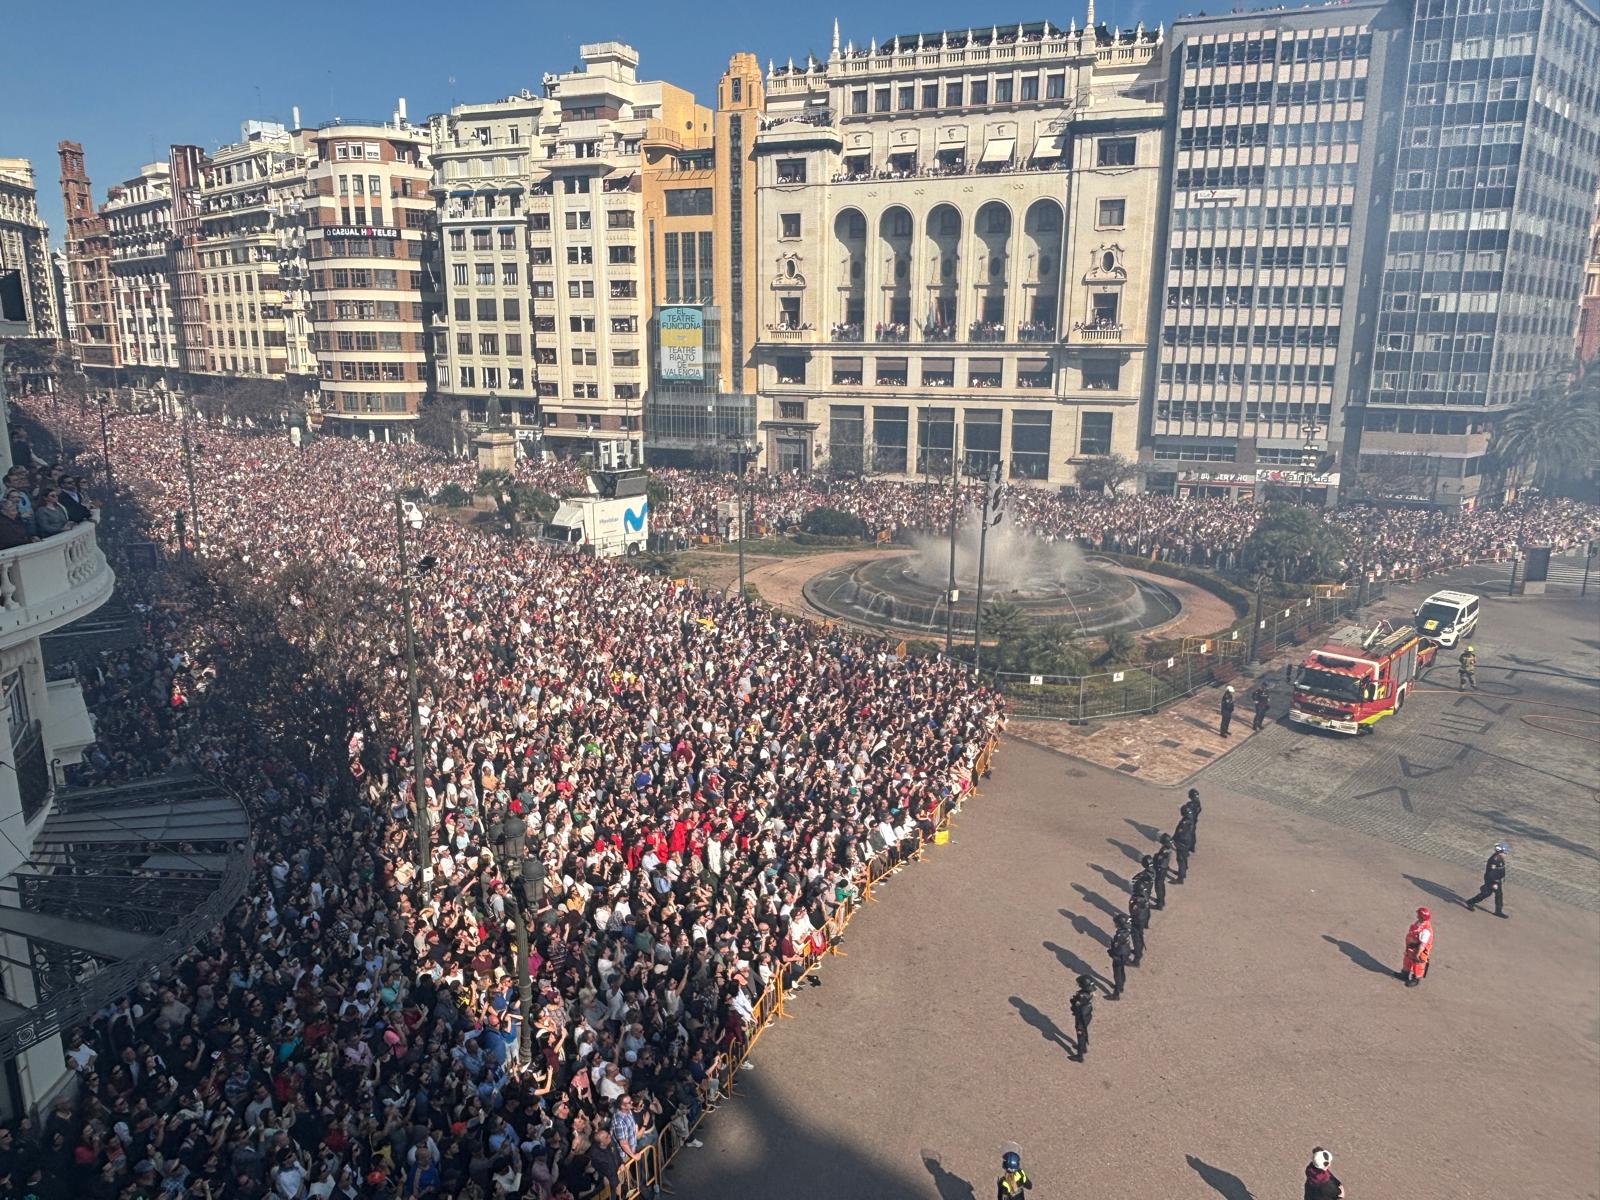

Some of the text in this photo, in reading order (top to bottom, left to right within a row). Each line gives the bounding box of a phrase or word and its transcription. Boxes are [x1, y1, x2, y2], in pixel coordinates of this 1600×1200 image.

[332, 228, 359, 236] CASUAL
[667, 346, 696, 354] TEATRE
[1200, 473, 1229, 481] BUGER
